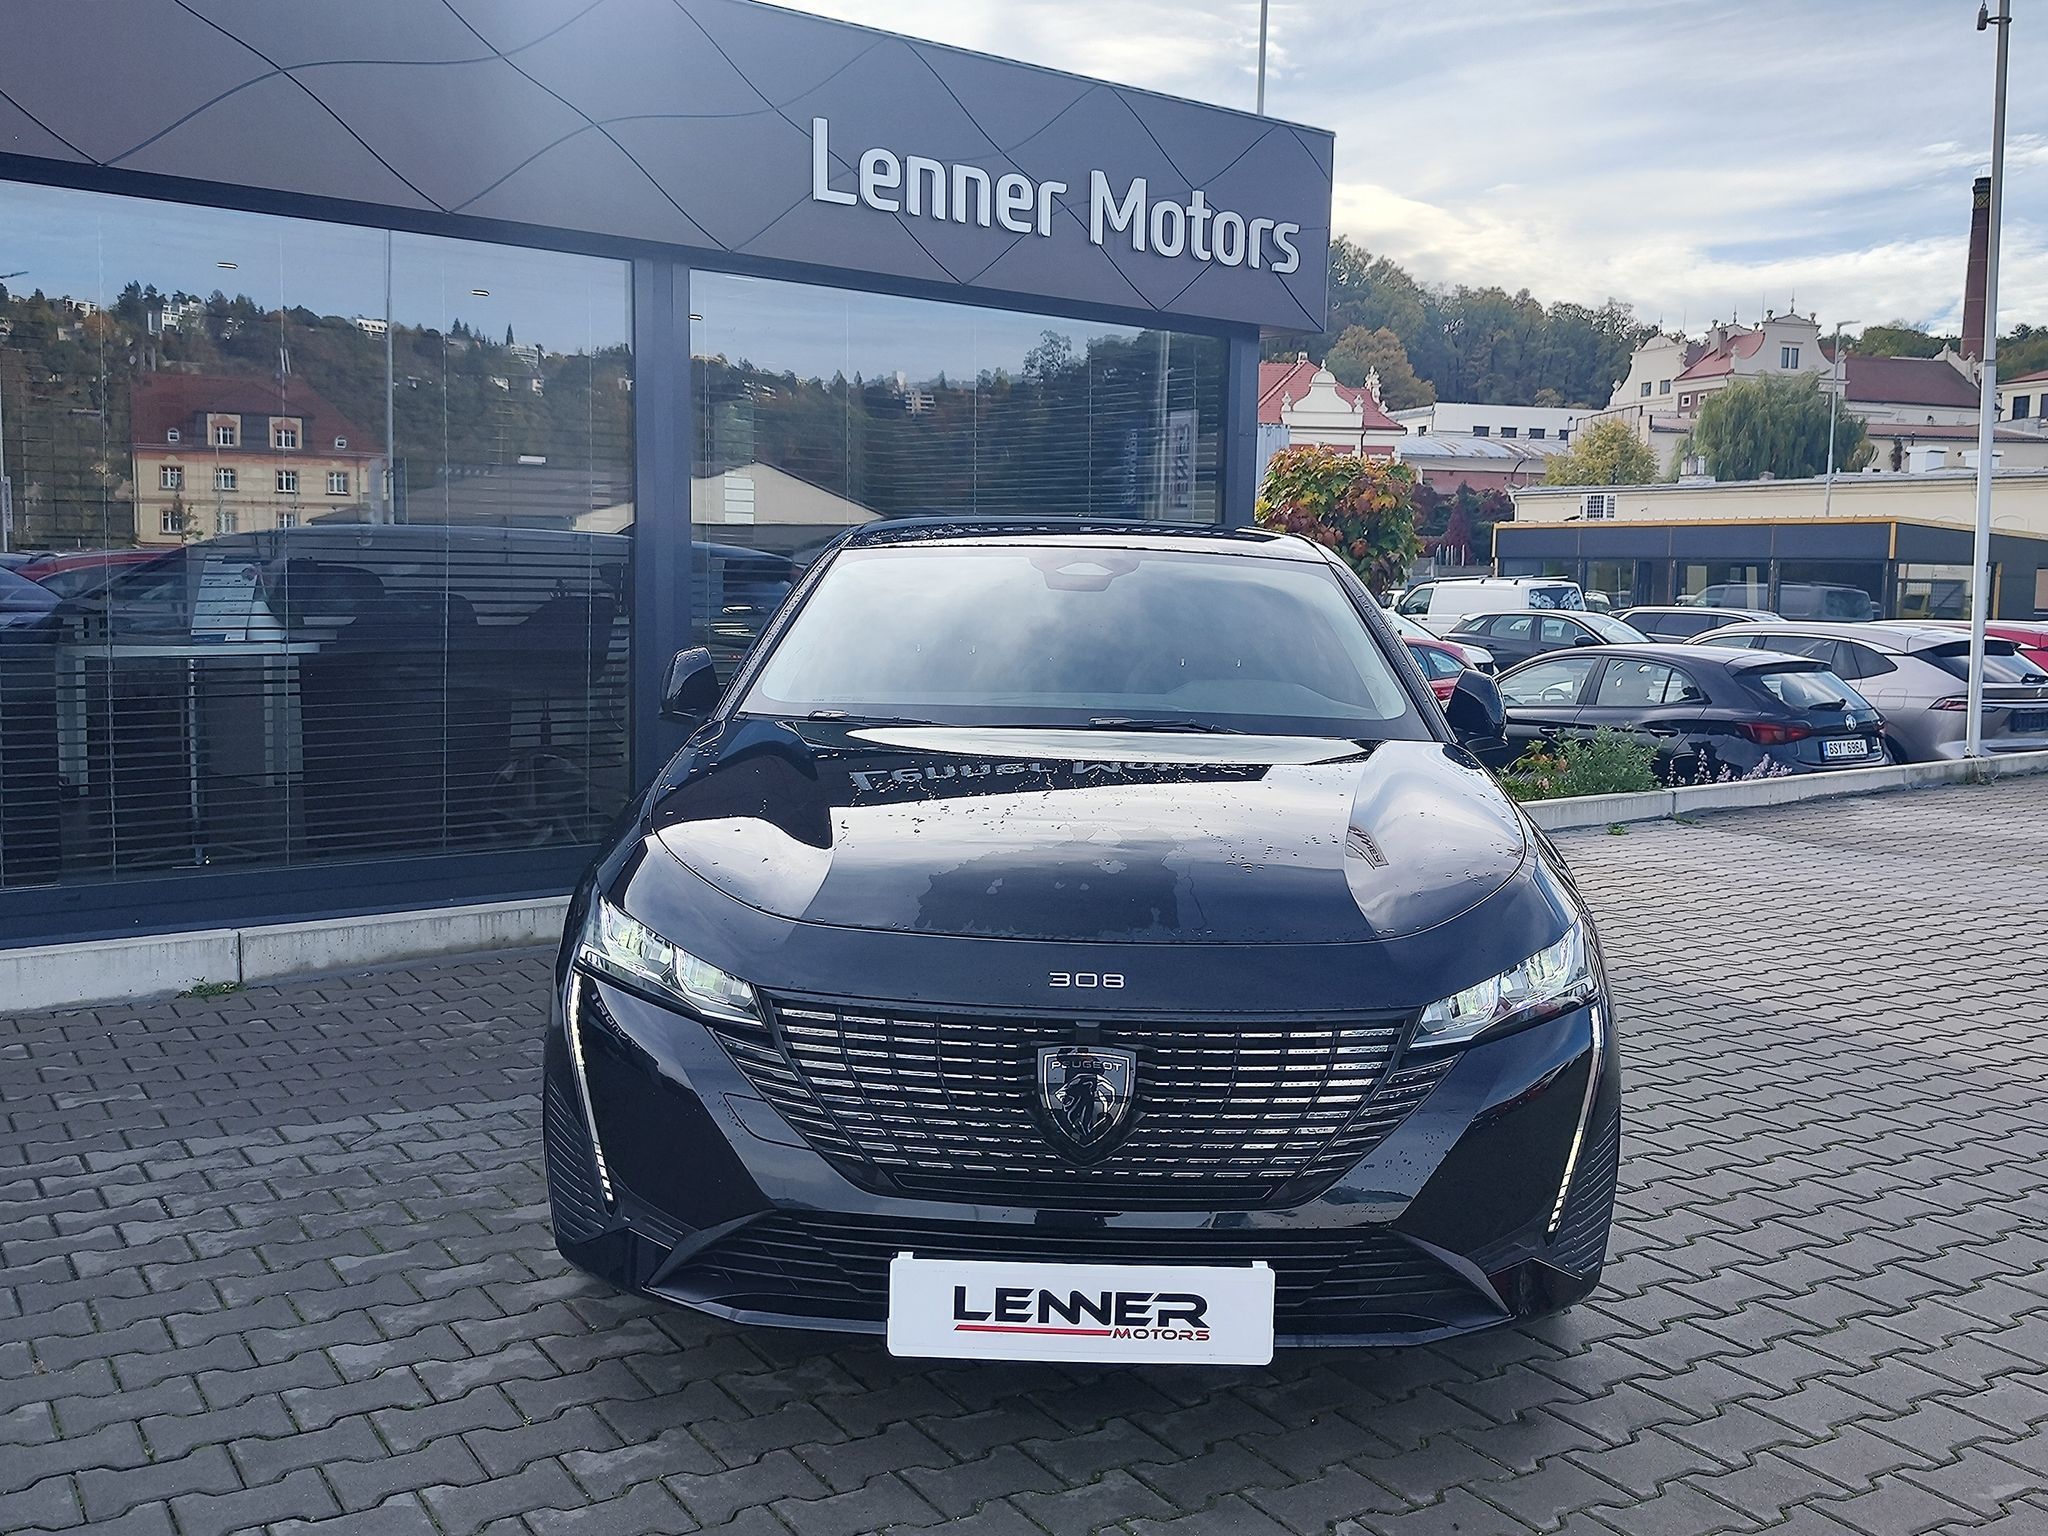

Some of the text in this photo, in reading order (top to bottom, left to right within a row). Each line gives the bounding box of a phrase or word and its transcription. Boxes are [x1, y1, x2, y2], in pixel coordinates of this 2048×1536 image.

[812, 117, 1300, 274] Lenner Motors
[1829, 742, 1842, 755] 6SY
[1049, 971, 1126, 989] 308
[1051, 1060, 1122, 1072] PEUGEOT
[953, 1284, 1209, 1329] LENNER
[1112, 1327, 1210, 1342] MOTORS
